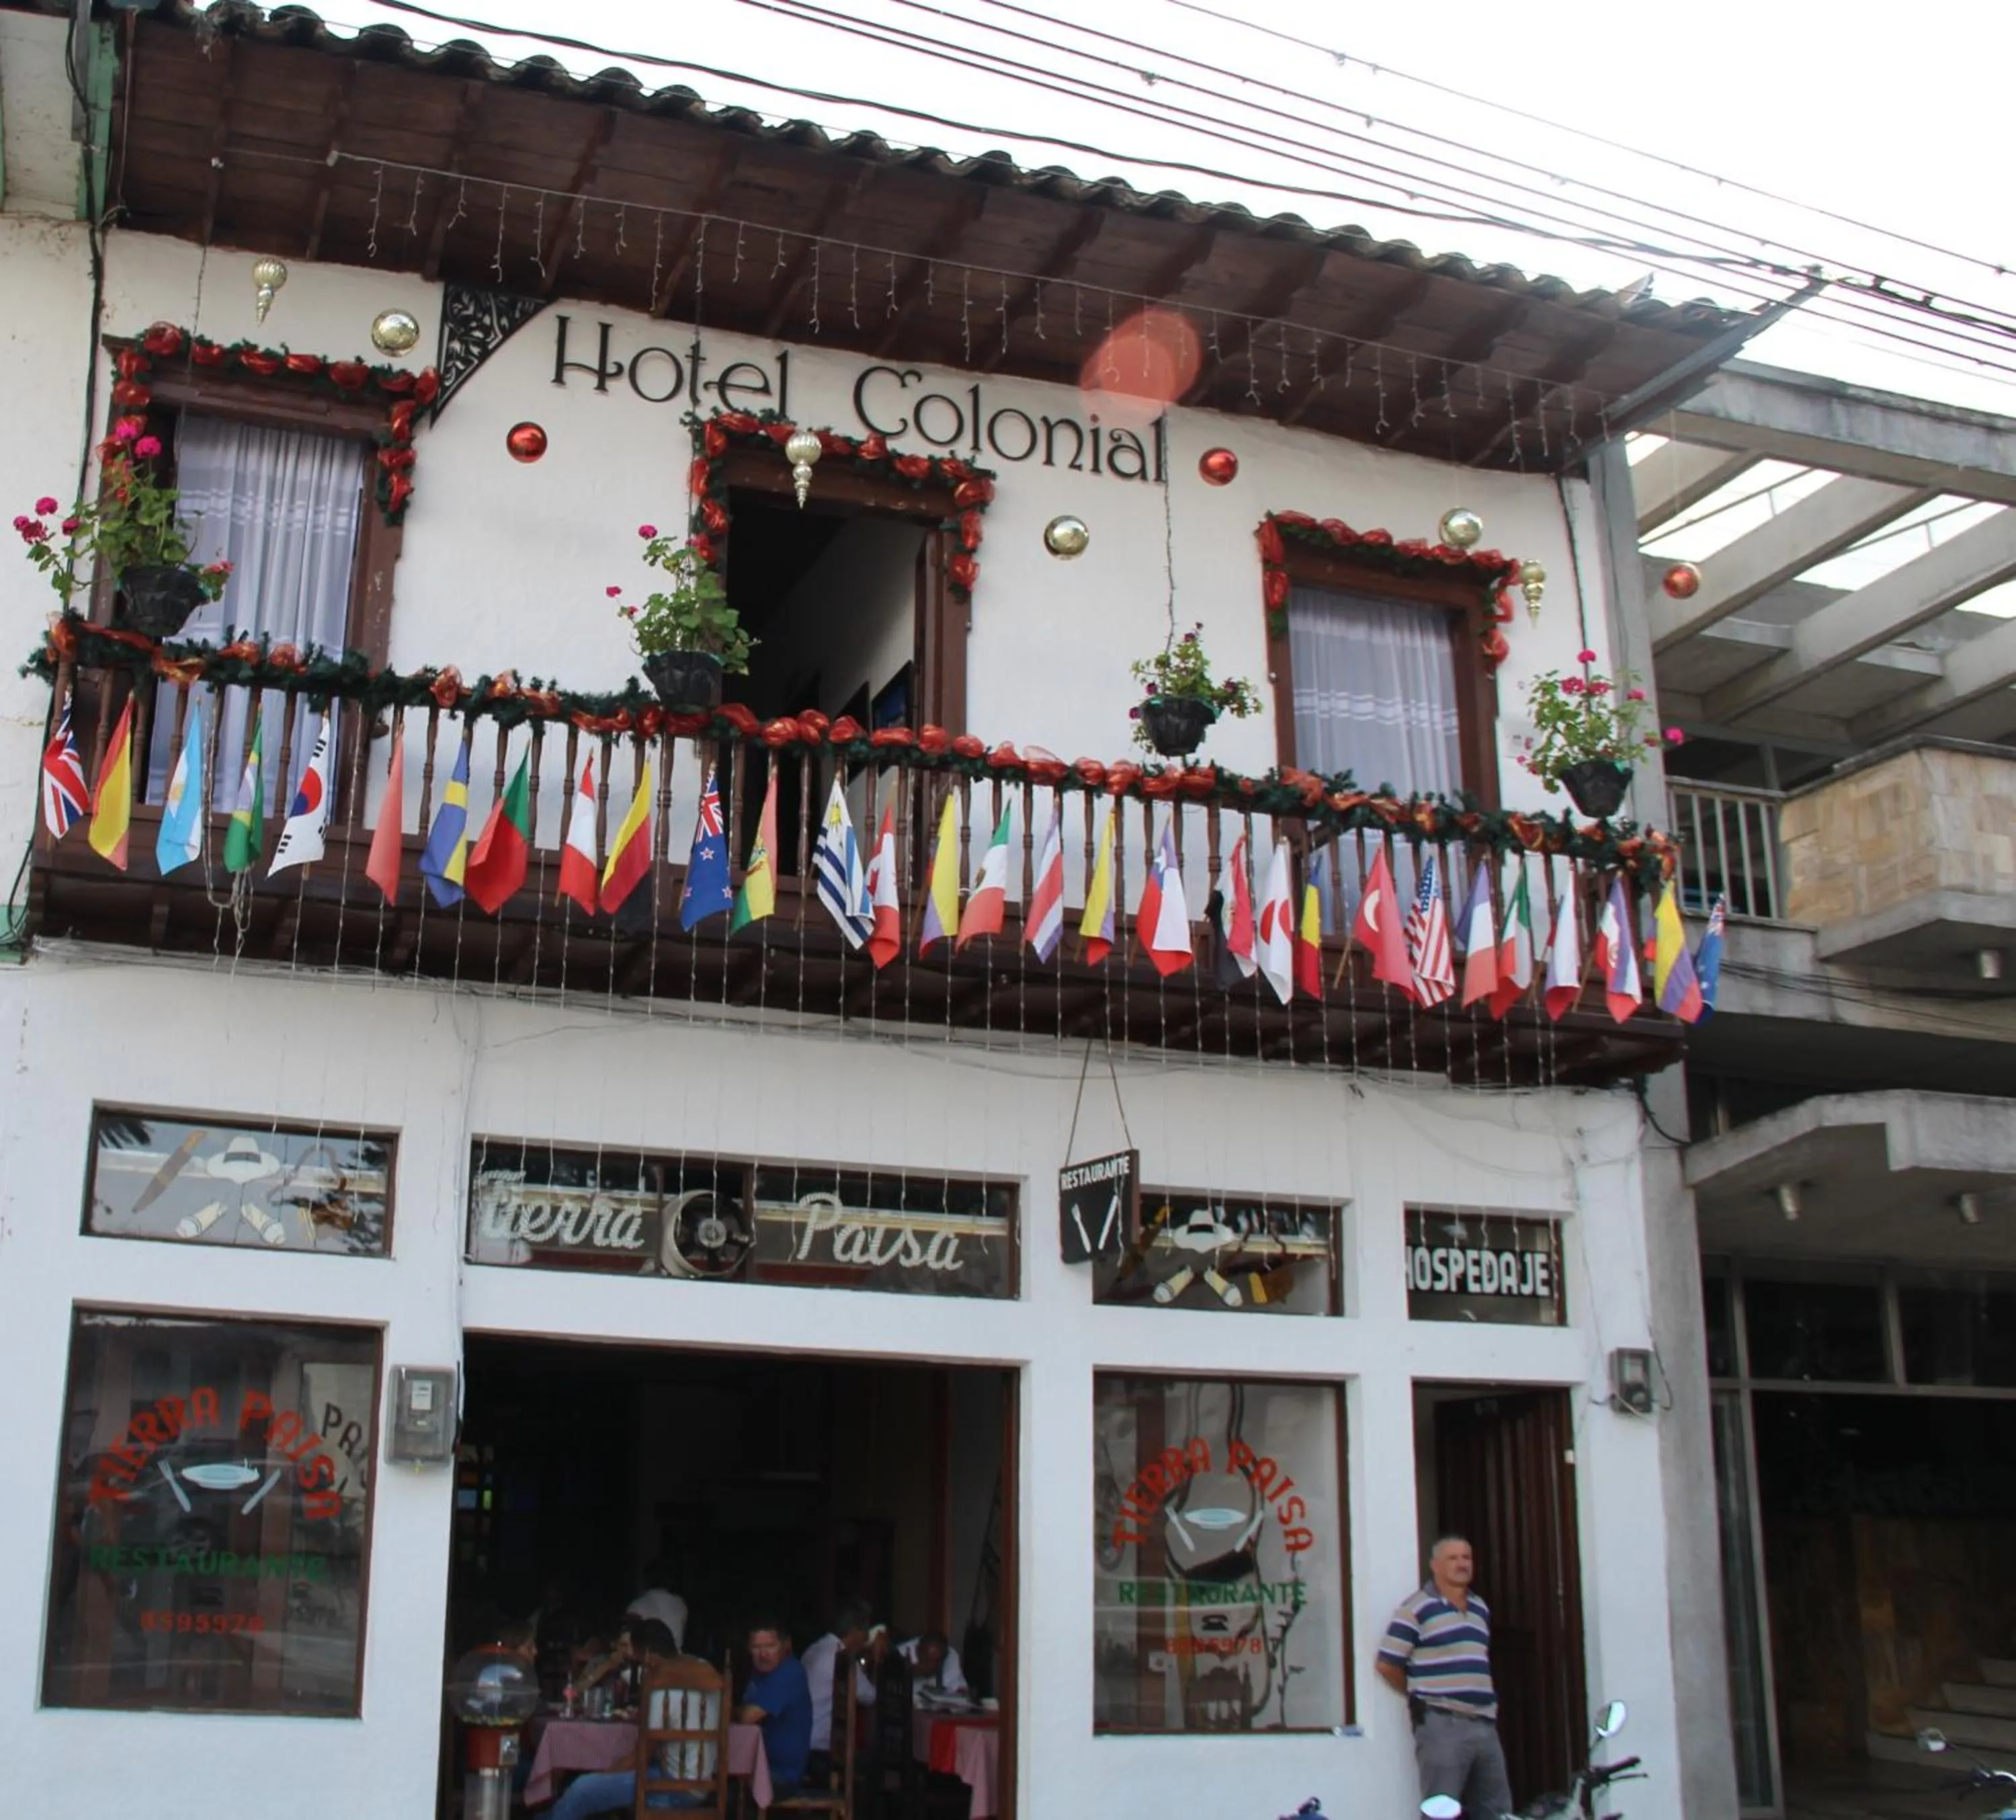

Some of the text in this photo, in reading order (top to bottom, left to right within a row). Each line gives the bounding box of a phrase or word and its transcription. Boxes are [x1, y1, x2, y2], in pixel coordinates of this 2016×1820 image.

[550, 315, 1169, 483] Hotel Colonial
[474, 1169, 966, 1272] Tierra Paisa
[1061, 1155, 1130, 1191] RESTAURANTE
[87, 1387, 343, 1520] TIERRA PAISA
[1112, 1436, 1314, 1553] TIERRA PAISA
[89, 1544, 328, 1582] RESTAURANTE
[1118, 1581, 1308, 1606] RESTAURANTE
